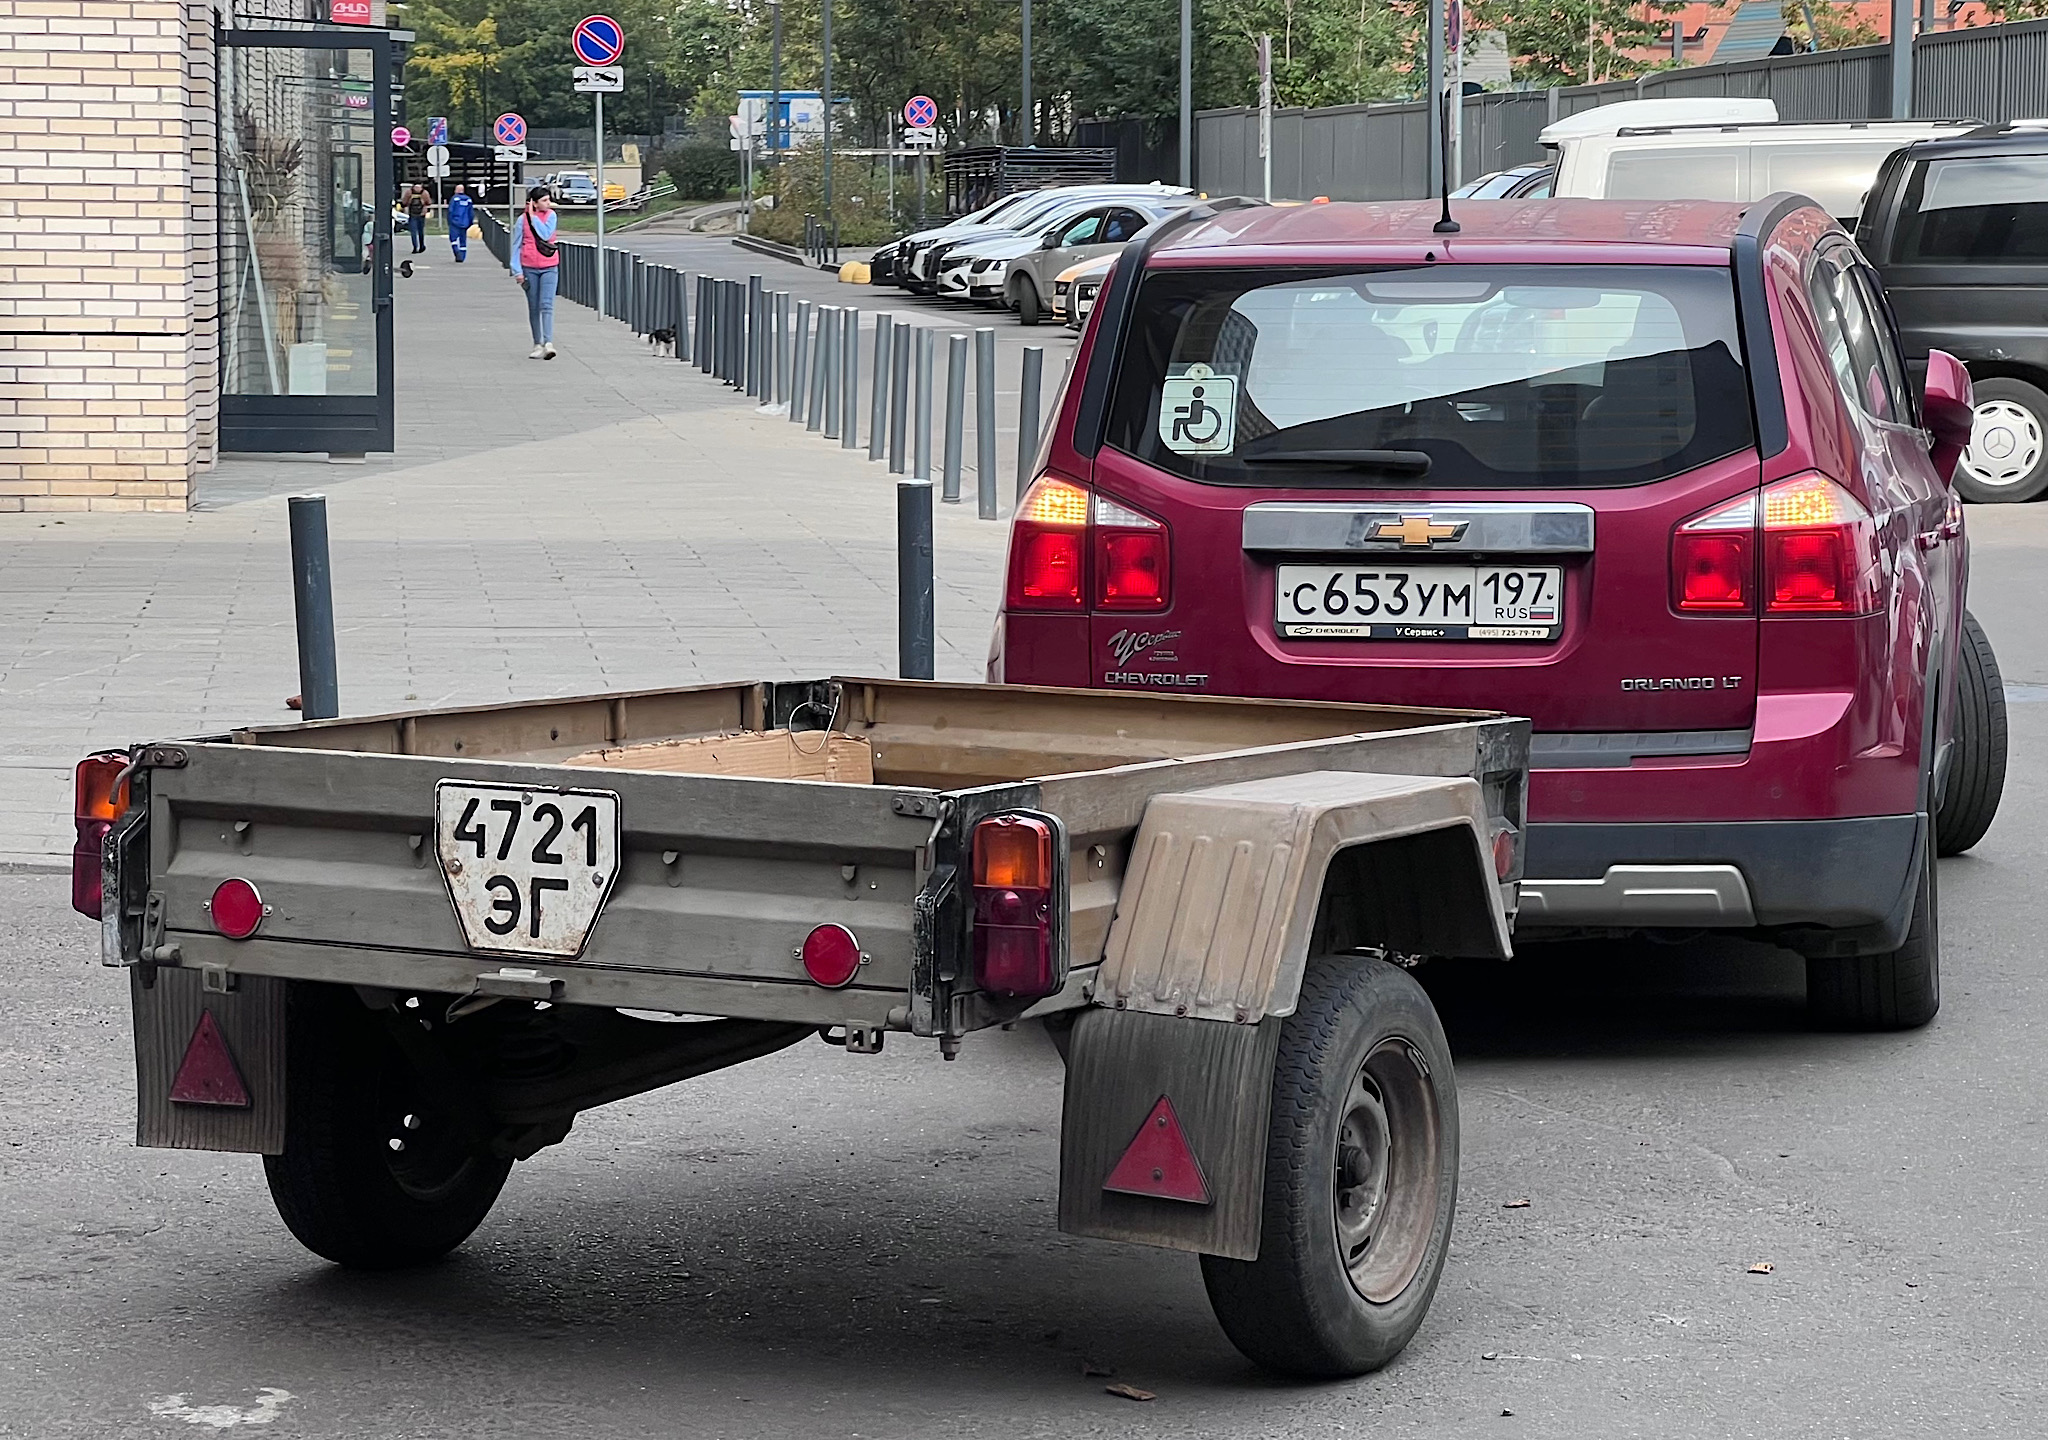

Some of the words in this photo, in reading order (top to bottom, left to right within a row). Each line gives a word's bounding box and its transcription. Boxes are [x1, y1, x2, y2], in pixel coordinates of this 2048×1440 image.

[1293, 573, 1471, 617] С653УМ
[1483, 572, 1547, 605] 197
[1495, 608, 1528, 619] RUS
[1478, 628, 1499, 637] (495)
[1104, 671, 1209, 686] CHEVROLET
[1620, 677, 1715, 691] ORLANDO
[1722, 676, 1742, 688] LT
[453, 798, 596, 867] 4721
[484, 874, 569, 938] ЭГ
